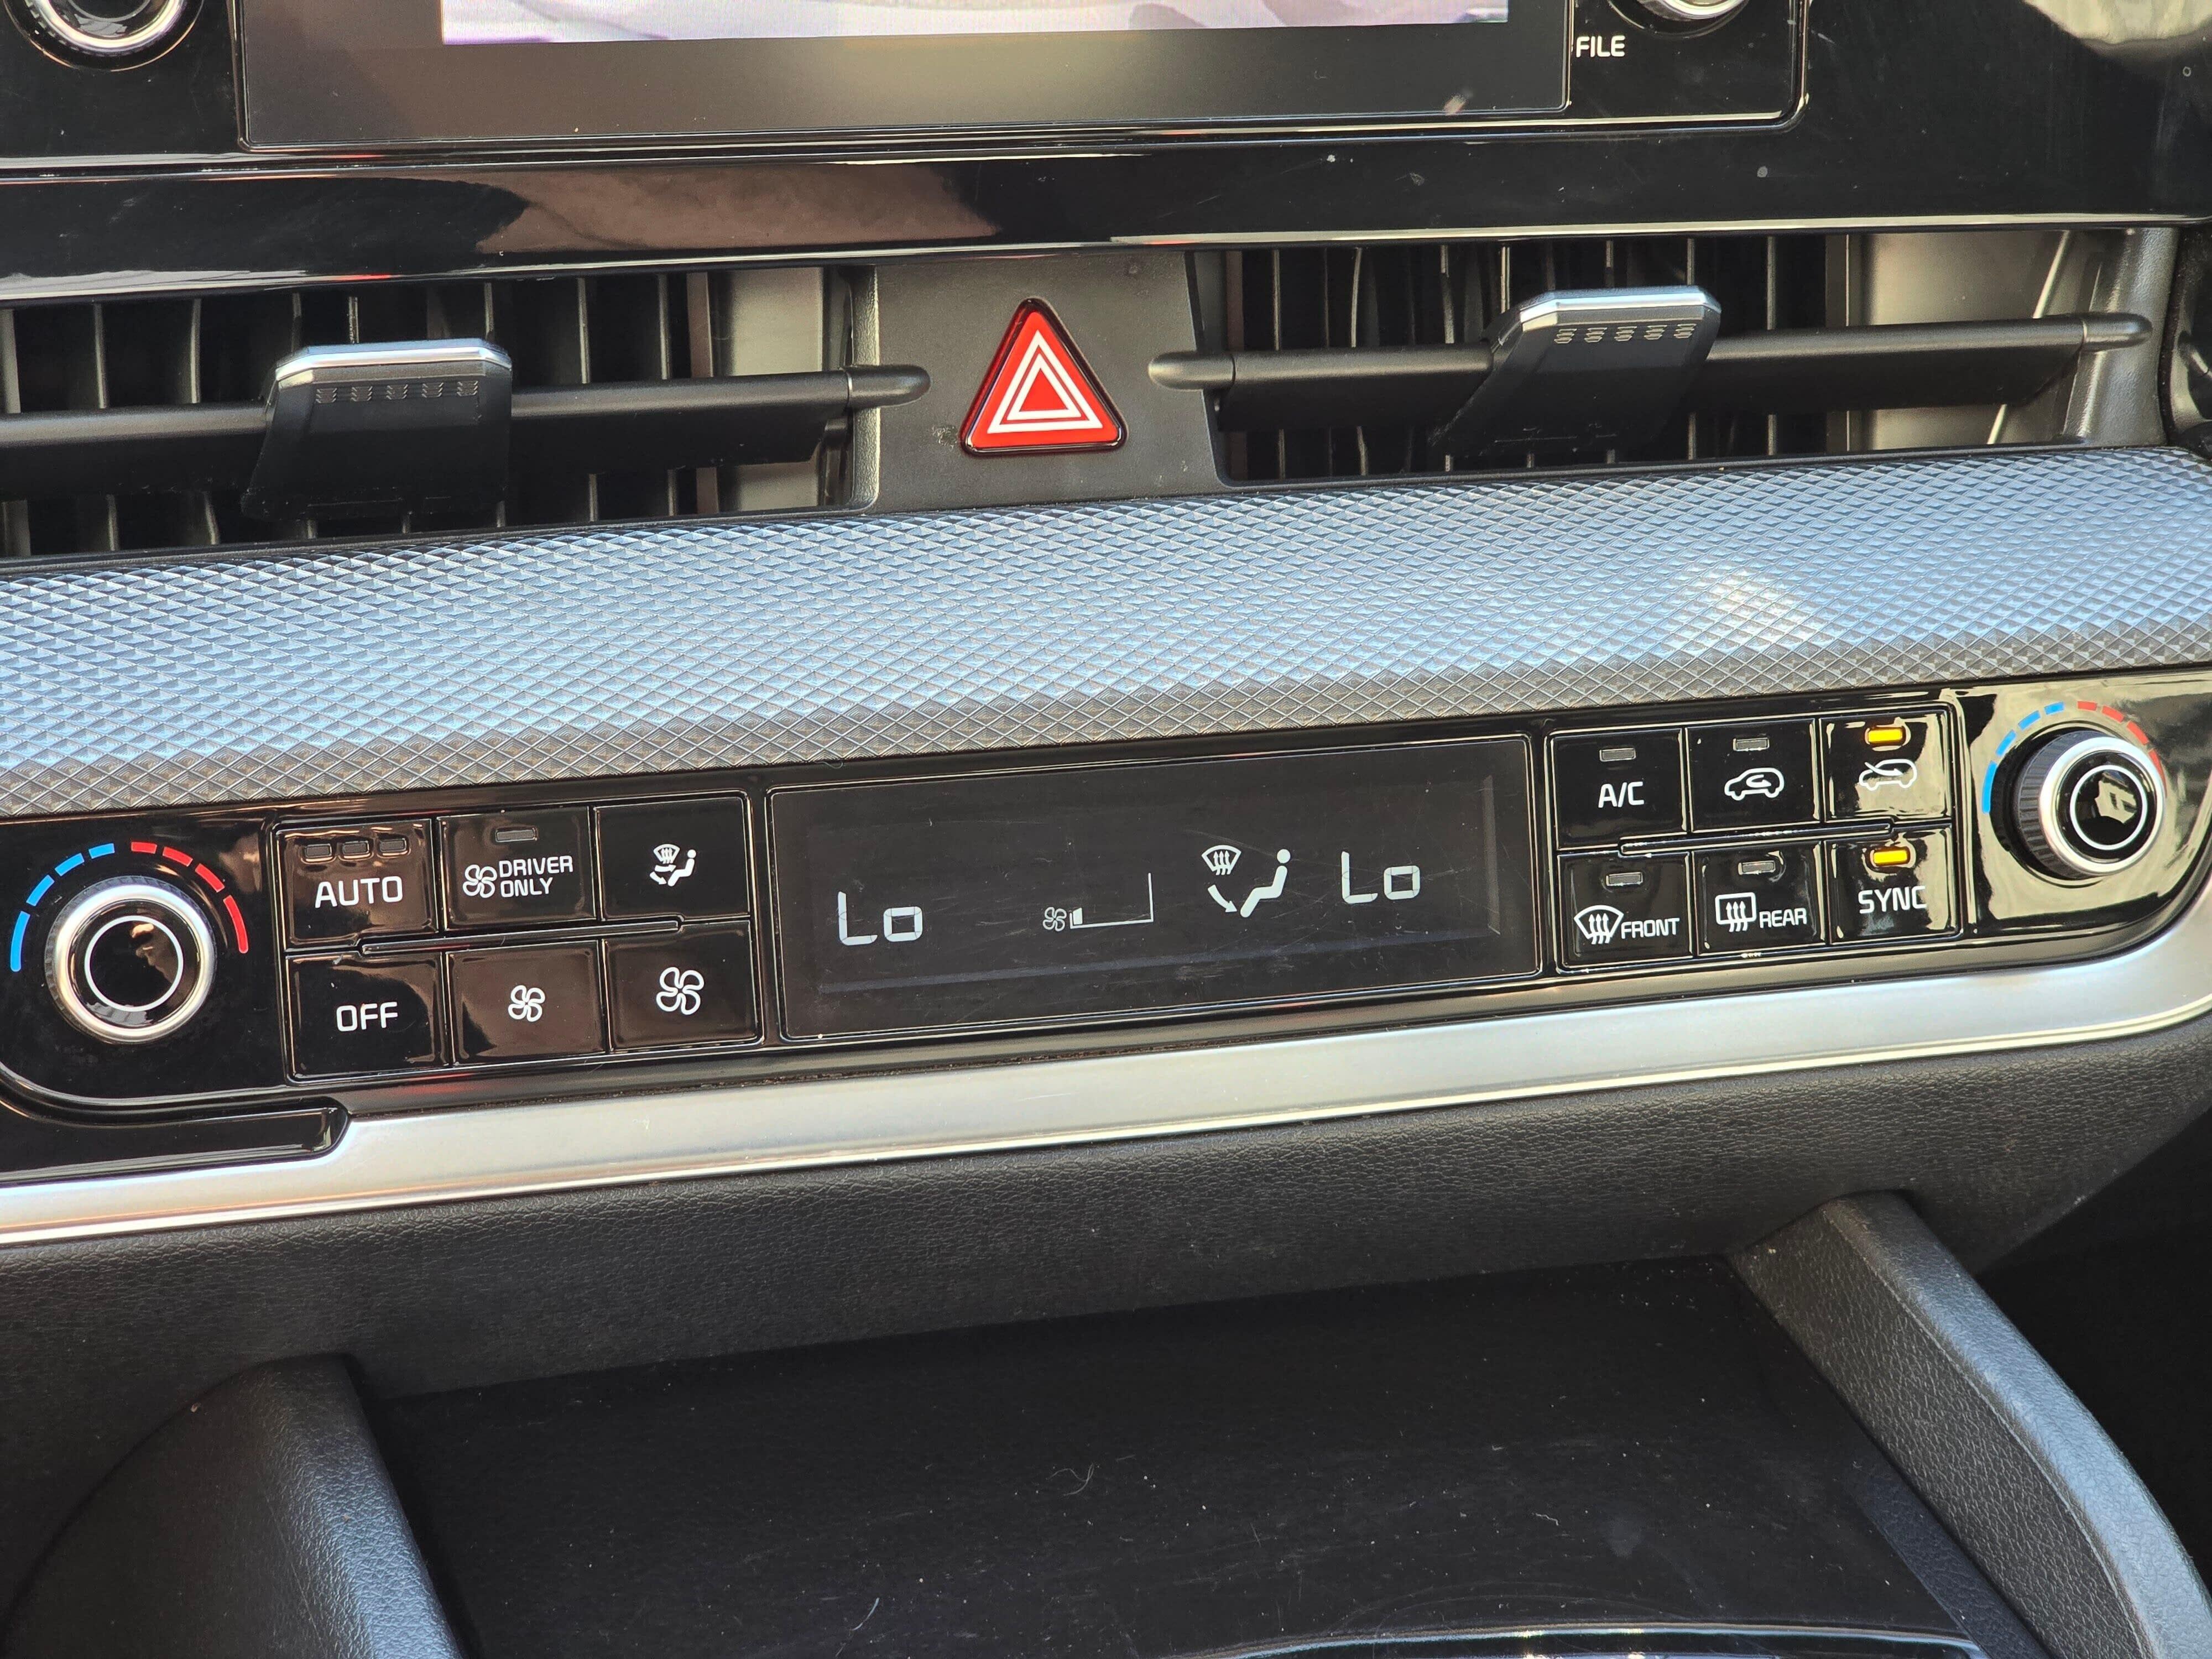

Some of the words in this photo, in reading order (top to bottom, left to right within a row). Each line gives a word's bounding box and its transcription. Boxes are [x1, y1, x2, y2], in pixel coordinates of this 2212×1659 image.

[1575, 35, 1626, 58] FILE
[1598, 781, 1645, 808] A/C
[499, 855, 574, 878] DRIVER
[1340, 851, 1421, 905] Lo
[315, 875, 404, 909] AUTO
[500, 877, 554, 899] ONLY
[1858, 886, 1927, 914] SYNC
[837, 891, 924, 946] Lo
[1620, 917, 1680, 940] FRONT
[1759, 907, 1808, 928] REAR
[336, 1001, 399, 1033] OFF
